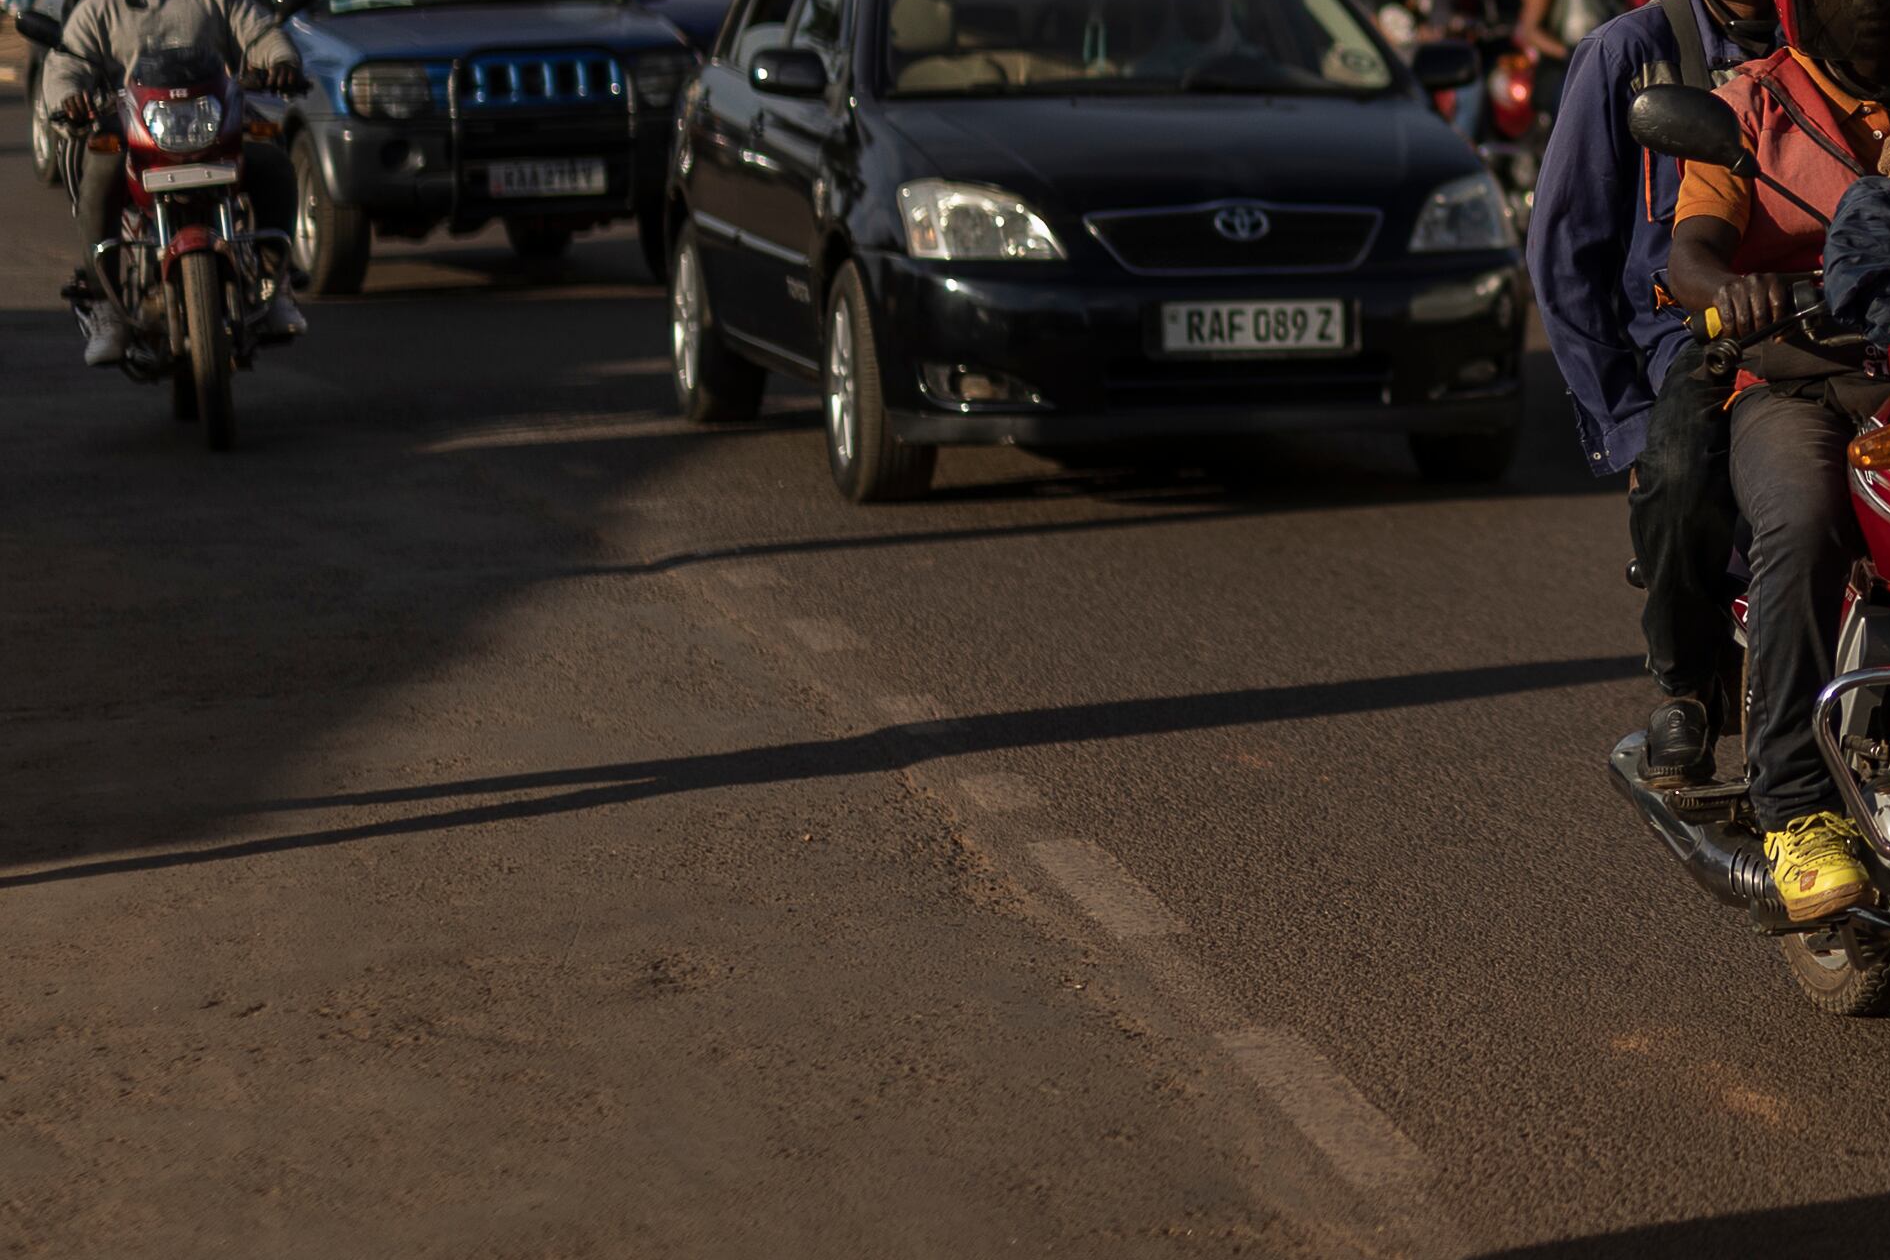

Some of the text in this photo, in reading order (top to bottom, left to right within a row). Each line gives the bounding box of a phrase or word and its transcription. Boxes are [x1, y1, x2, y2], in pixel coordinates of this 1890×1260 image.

[1186, 306, 1334, 344] RAF 089 Z
